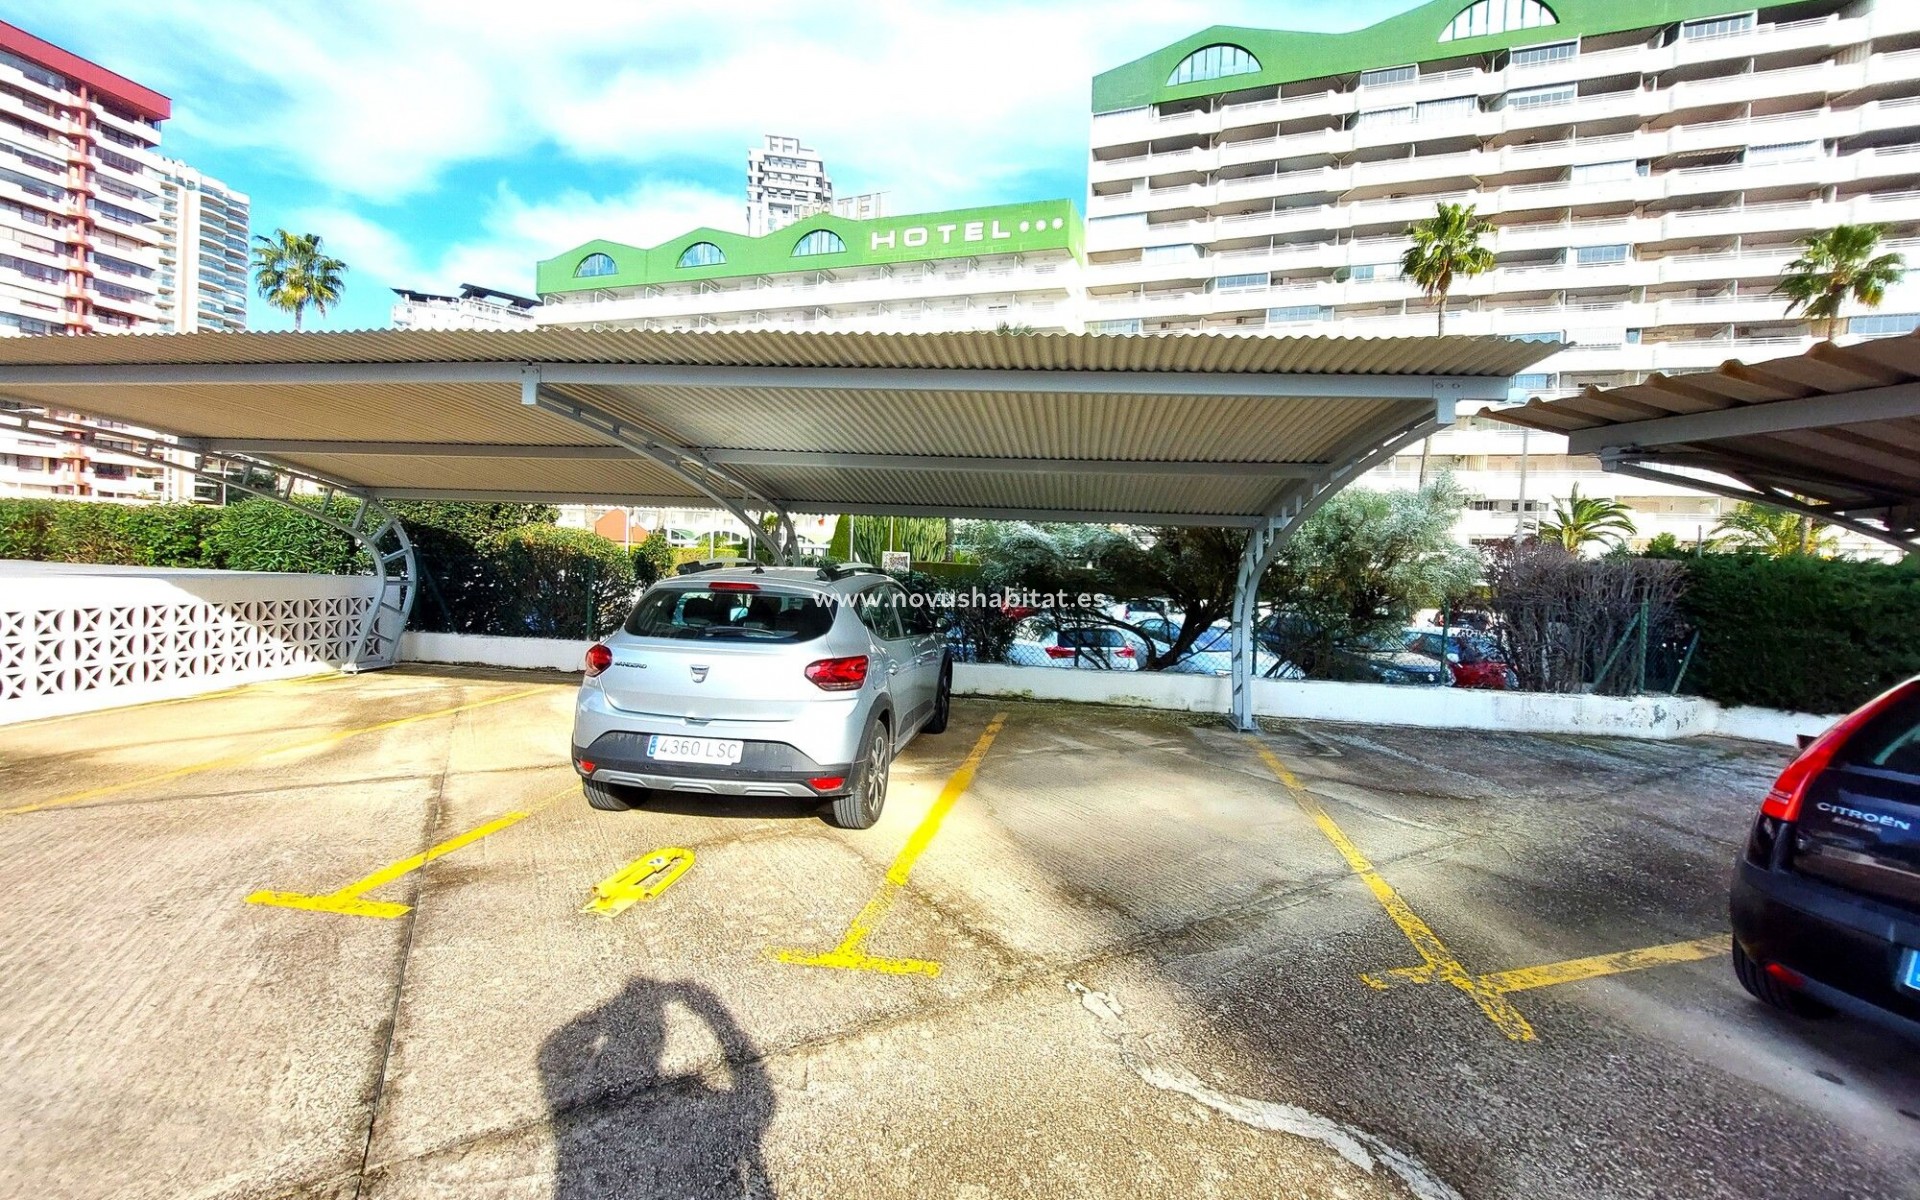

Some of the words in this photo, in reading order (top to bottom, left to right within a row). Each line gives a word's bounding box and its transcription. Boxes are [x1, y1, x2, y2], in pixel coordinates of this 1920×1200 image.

[870, 219, 1012, 251] HOTEL
[659, 738, 701, 756] 4360
[705, 742, 738, 759] LSC
[1816, 801, 1911, 831] CITROËN
